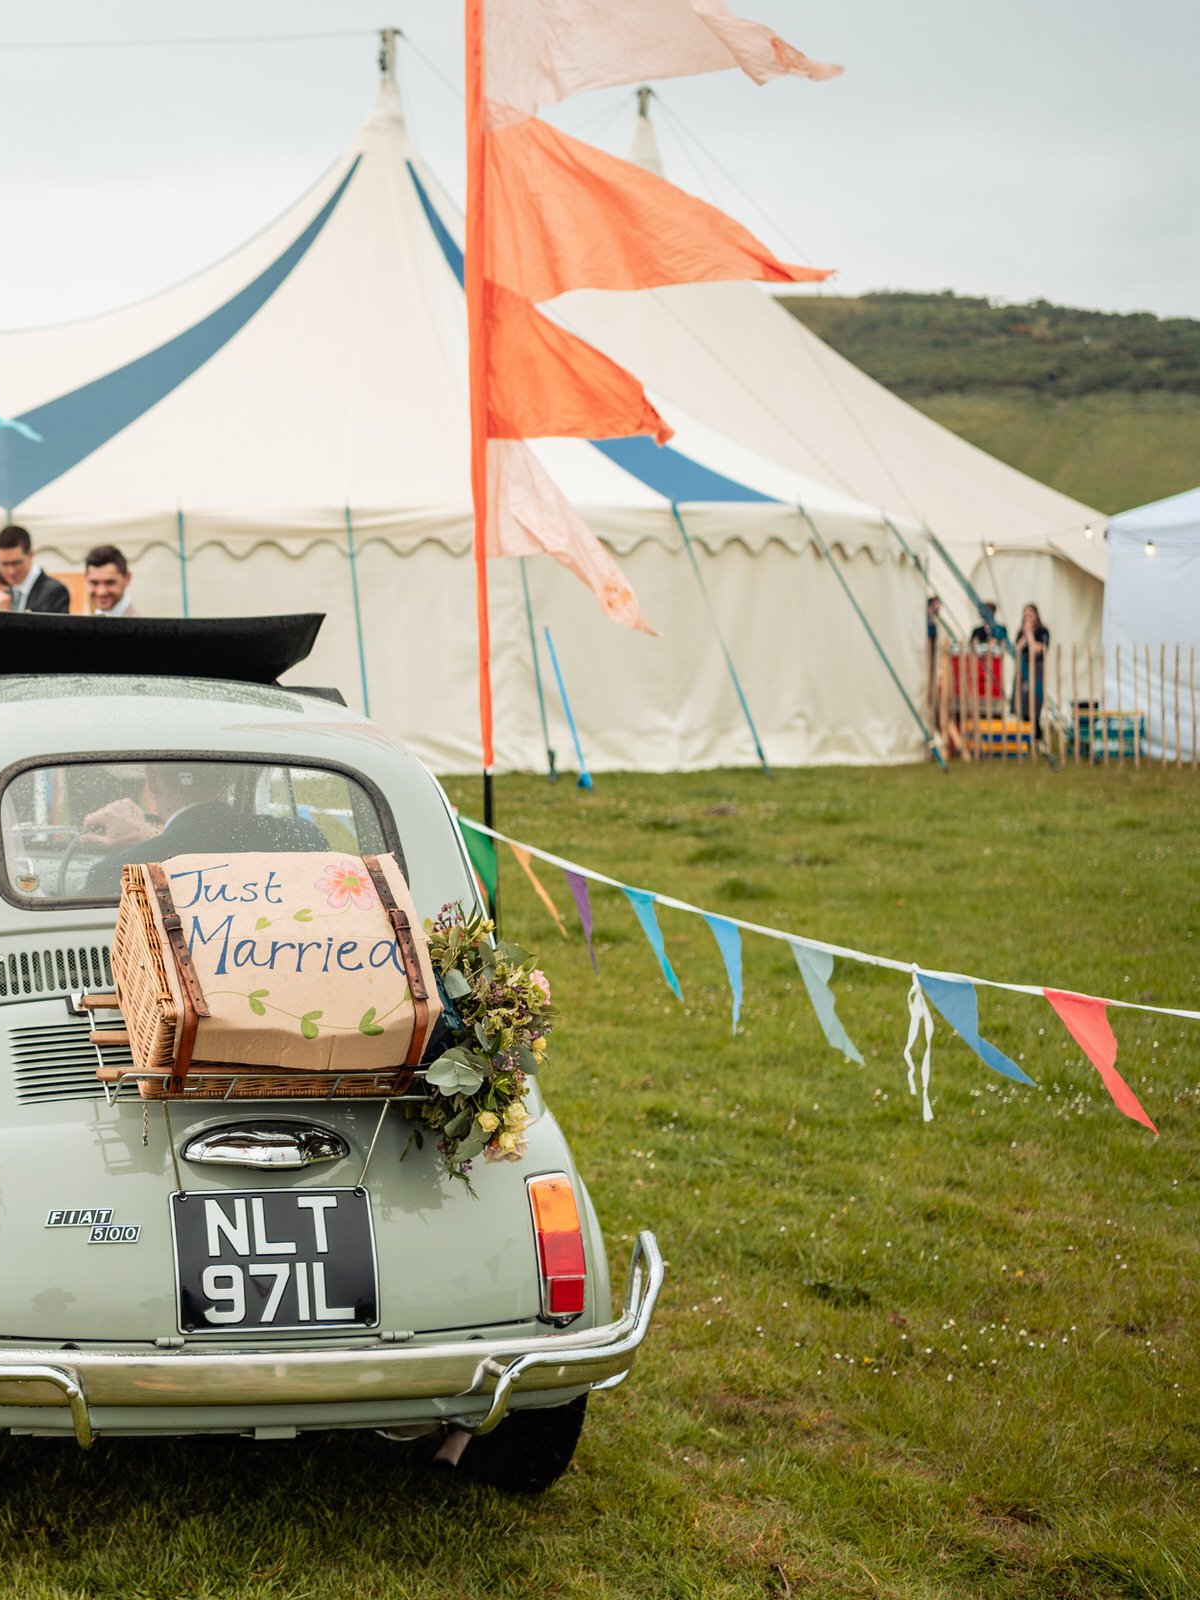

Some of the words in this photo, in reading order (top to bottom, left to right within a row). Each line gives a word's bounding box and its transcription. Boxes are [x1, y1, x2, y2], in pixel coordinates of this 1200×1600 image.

[170, 864, 283, 908] Just
[187, 914, 406, 976] Married
[49, 1210, 111, 1224] FIAT
[93, 1227, 137, 1241] 500
[204, 1195, 339, 1257] NLT
[202, 1261, 355, 1324] 971L
